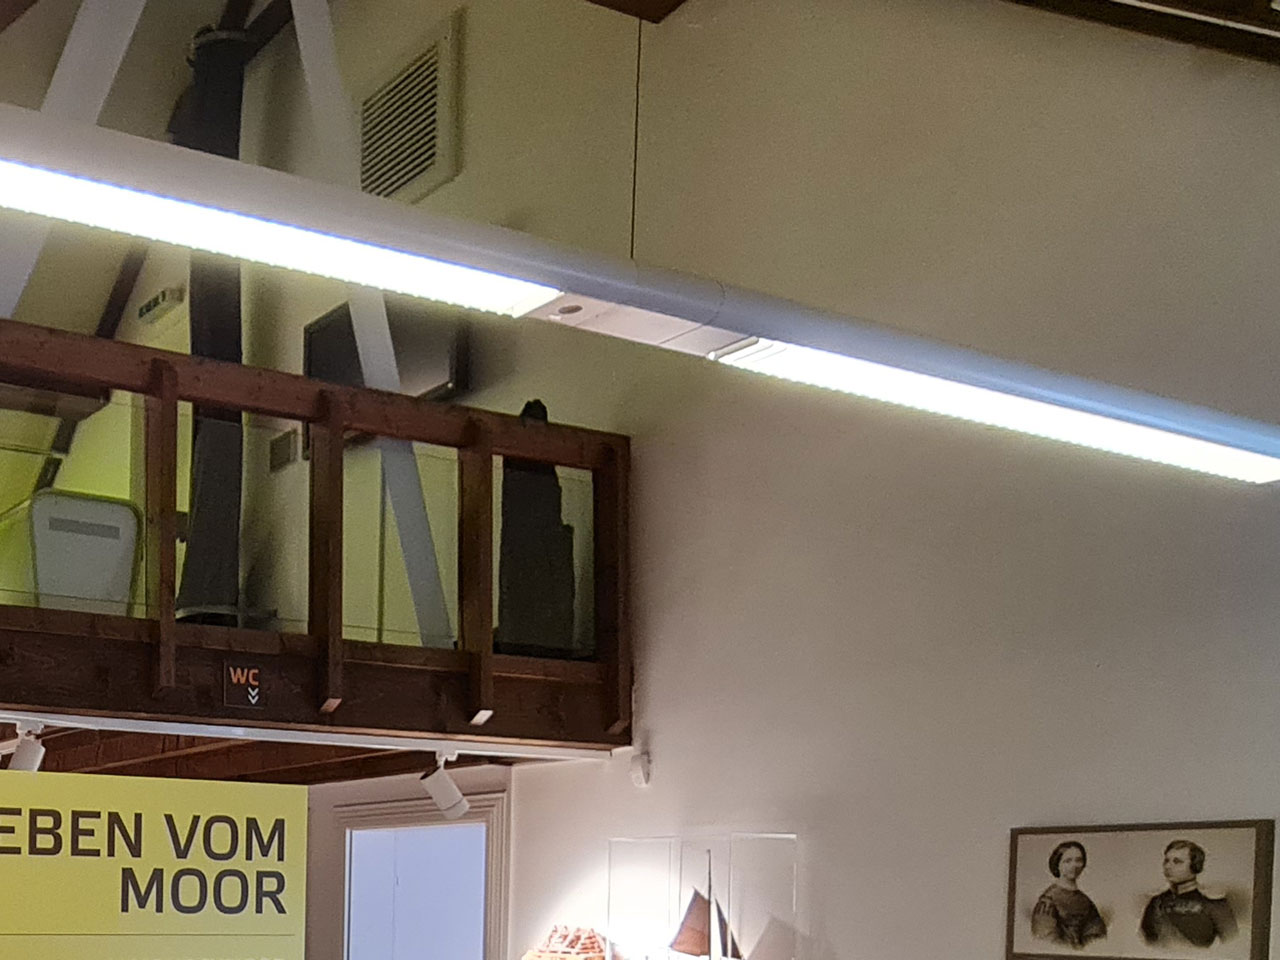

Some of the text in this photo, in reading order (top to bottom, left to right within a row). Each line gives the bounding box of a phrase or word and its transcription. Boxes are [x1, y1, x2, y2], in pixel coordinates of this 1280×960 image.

[229, 666, 259, 686] WC
[164, 812, 286, 863] VOM
[120, 867, 287, 914] MOOR
